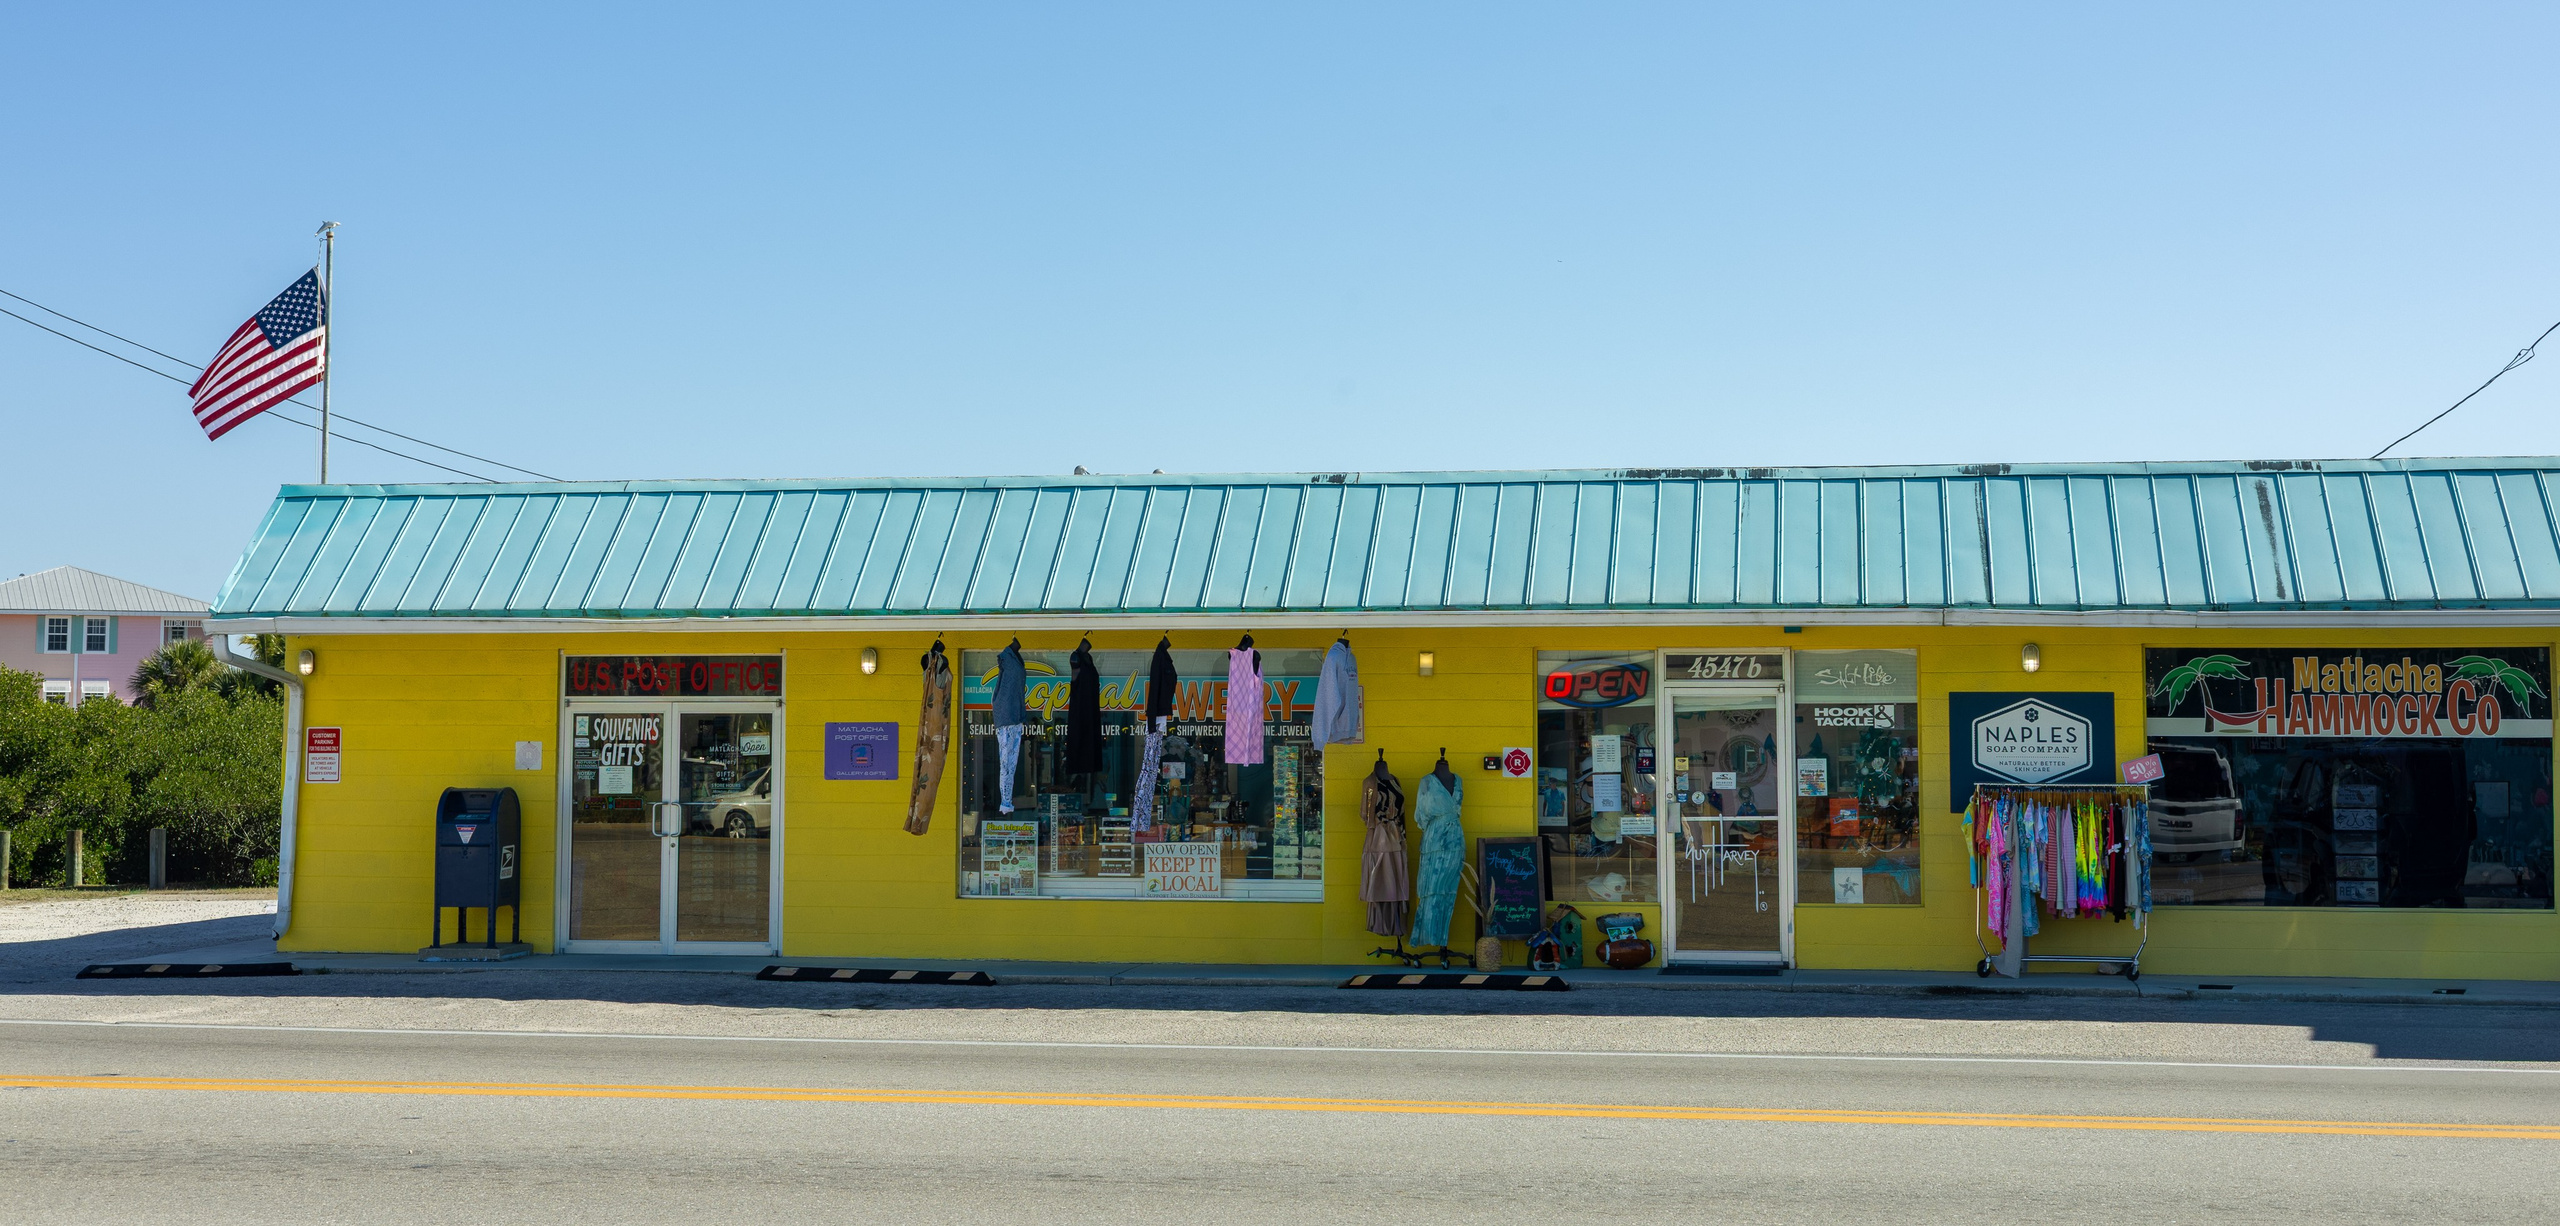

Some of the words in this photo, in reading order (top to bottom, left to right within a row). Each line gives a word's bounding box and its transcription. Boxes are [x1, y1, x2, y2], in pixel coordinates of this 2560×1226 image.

[574, 662, 616, 691] U.S.
[623, 662, 686, 691] POST
[690, 662, 779, 691] OFFICE
[2292, 656, 2443, 694] Matlacha
[981, 660, 1139, 722] Topal
[1545, 670, 1648, 698] OPEN
[1814, 707, 1873, 717] HOOK
[2254, 677, 2442, 737] HAMMOCK
[593, 718, 660, 741] SOUVENIRS
[1101, 725, 1120, 735] LVER
[1176, 725, 1223, 736] SHIPWRECK
[1814, 717, 1873, 727] TACKLE
[1985, 727, 2078, 743] NAPLES
[601, 743, 646, 766] GIFTS
[744, 742, 767, 753] Open
[1514, 758, 1521, 766] R
[2129, 759, 2157, 780] 50%
[2144, 767, 2157, 779] OFF
[1146, 844, 1176, 855] NOW
[1179, 844, 1218, 855] OPEN!
[1148, 857, 1195, 873] KEEP
[1199, 857, 1217, 873] IT
[1702, 813, 1760, 913] HARVEY
[1161, 875, 1219, 892] LOCAL
